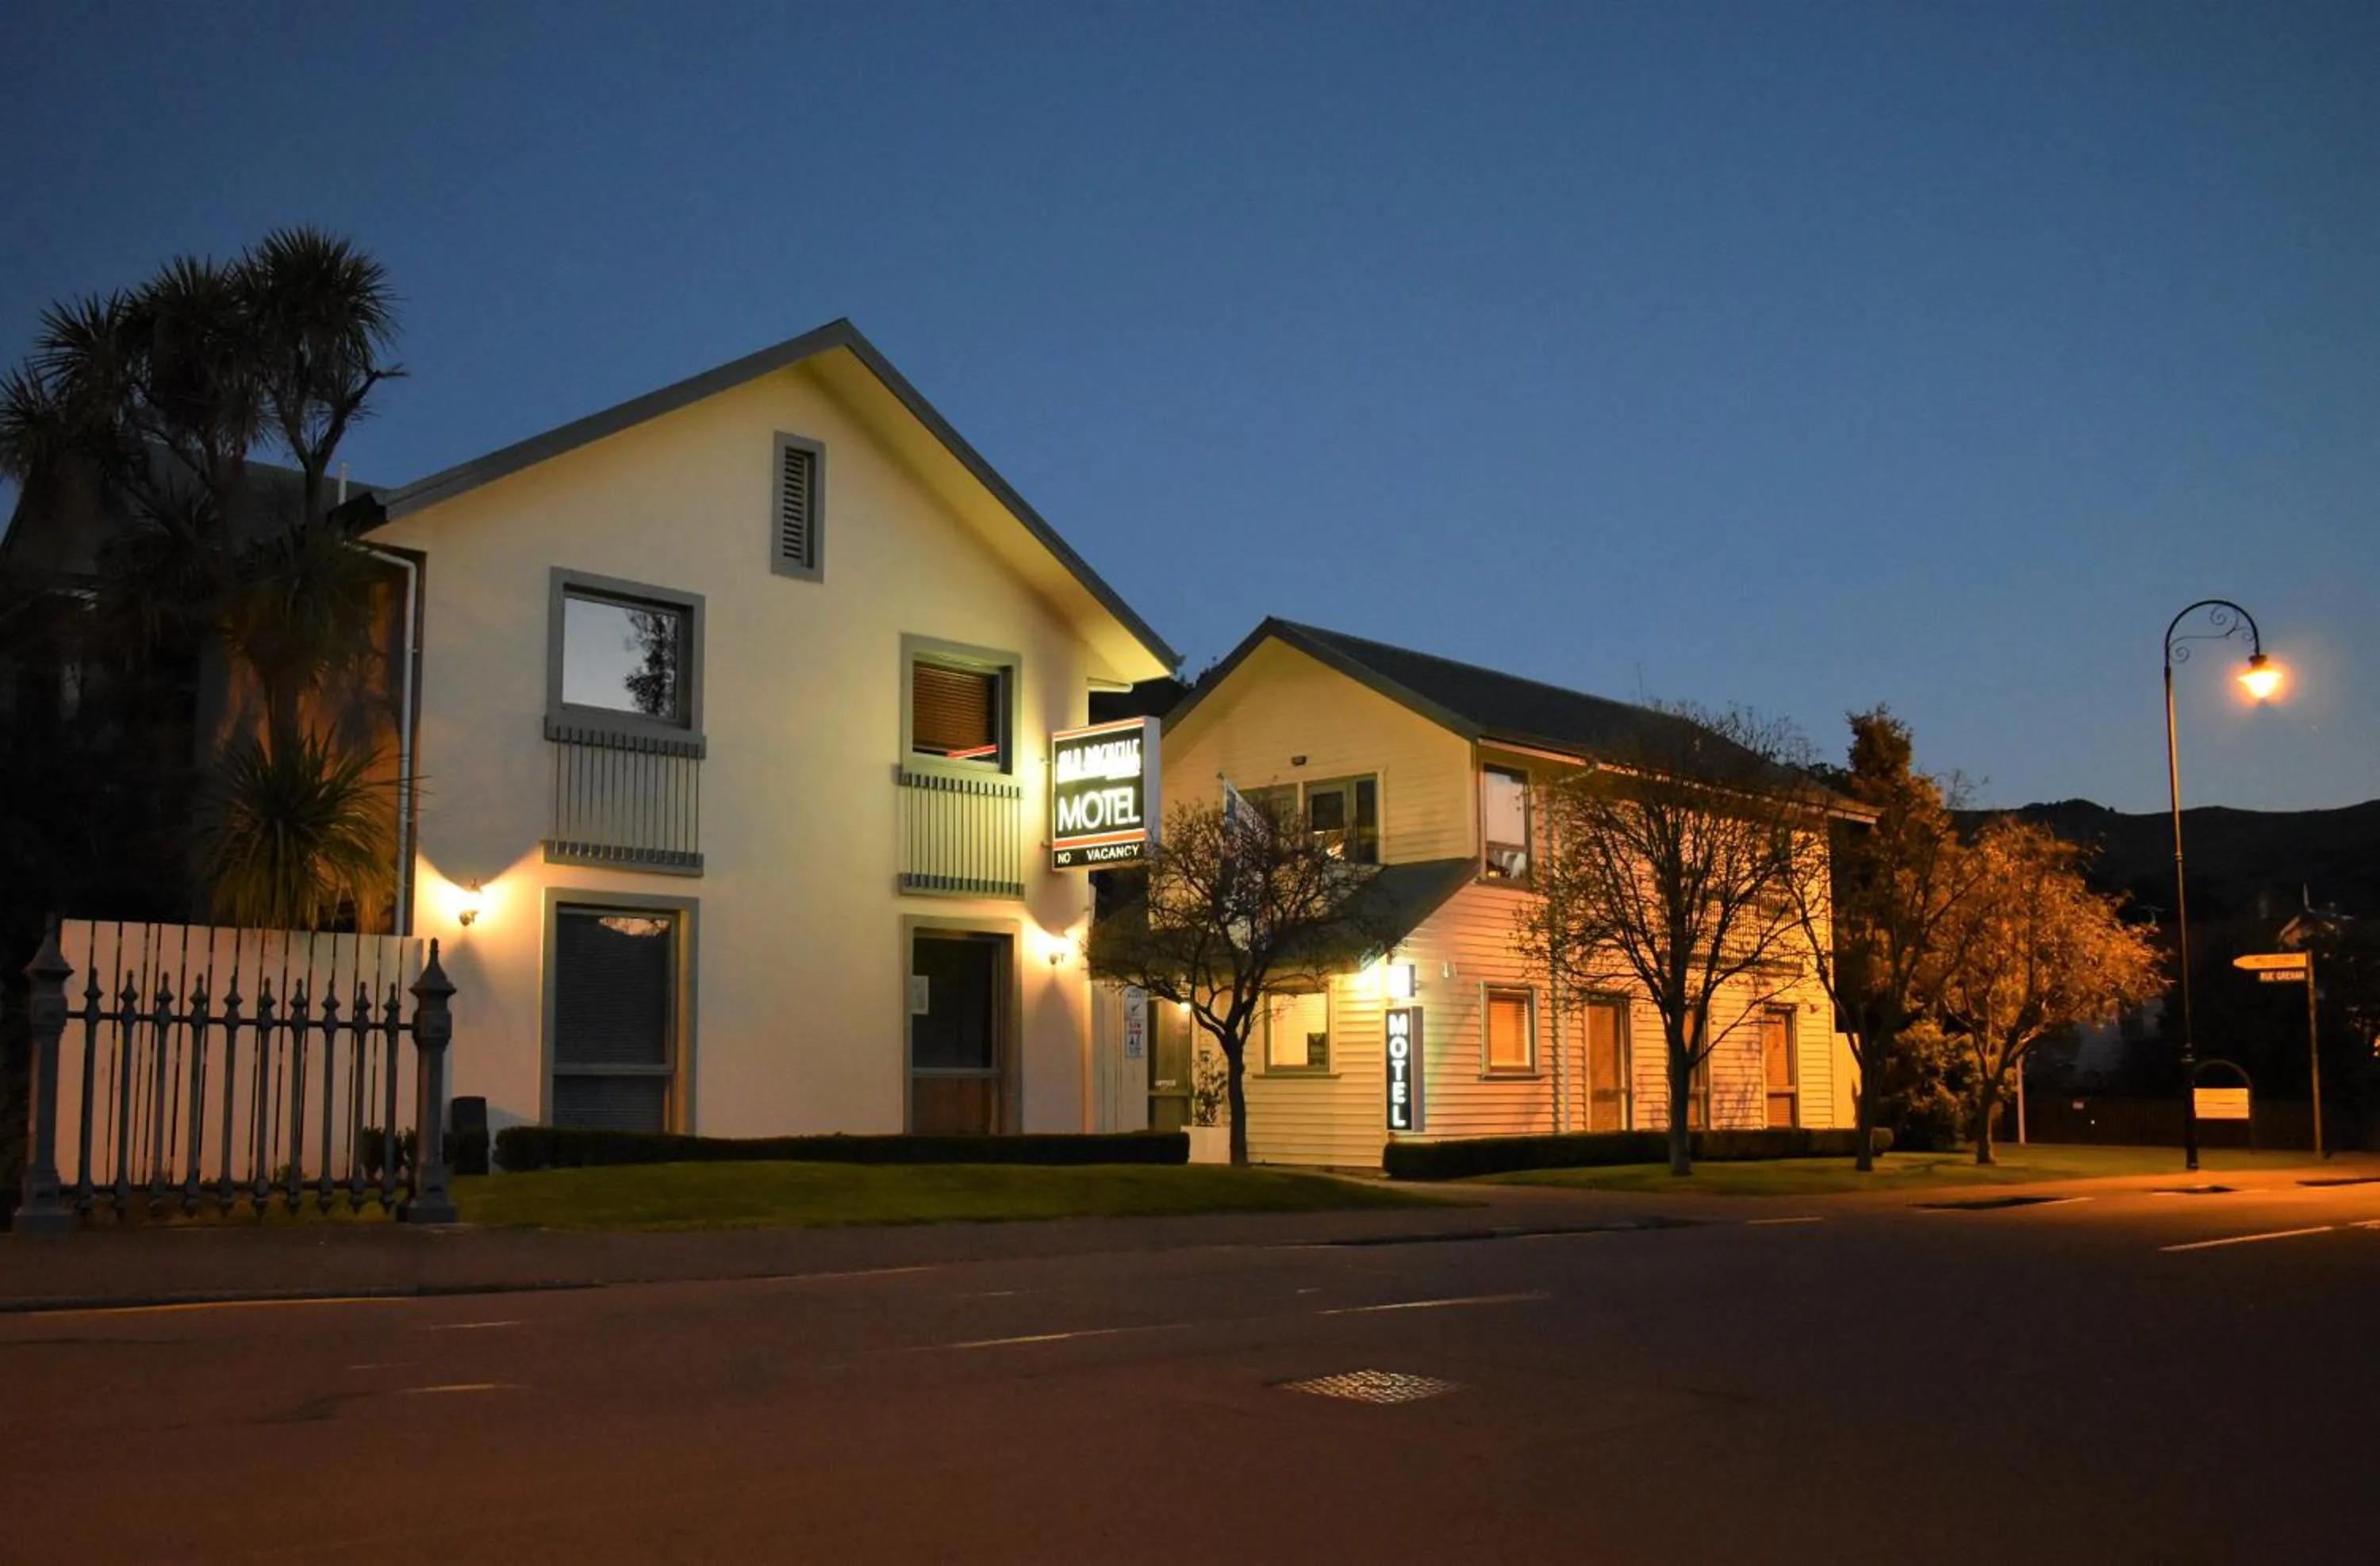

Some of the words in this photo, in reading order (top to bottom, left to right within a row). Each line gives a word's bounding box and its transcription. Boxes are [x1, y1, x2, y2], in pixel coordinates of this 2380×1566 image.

[1058, 787, 1141, 831] MOTEL
[1058, 851, 1072, 864] NO
[1086, 843, 1140, 862] VACANCY
[1388, 1013, 1409, 1127] MOTEL
